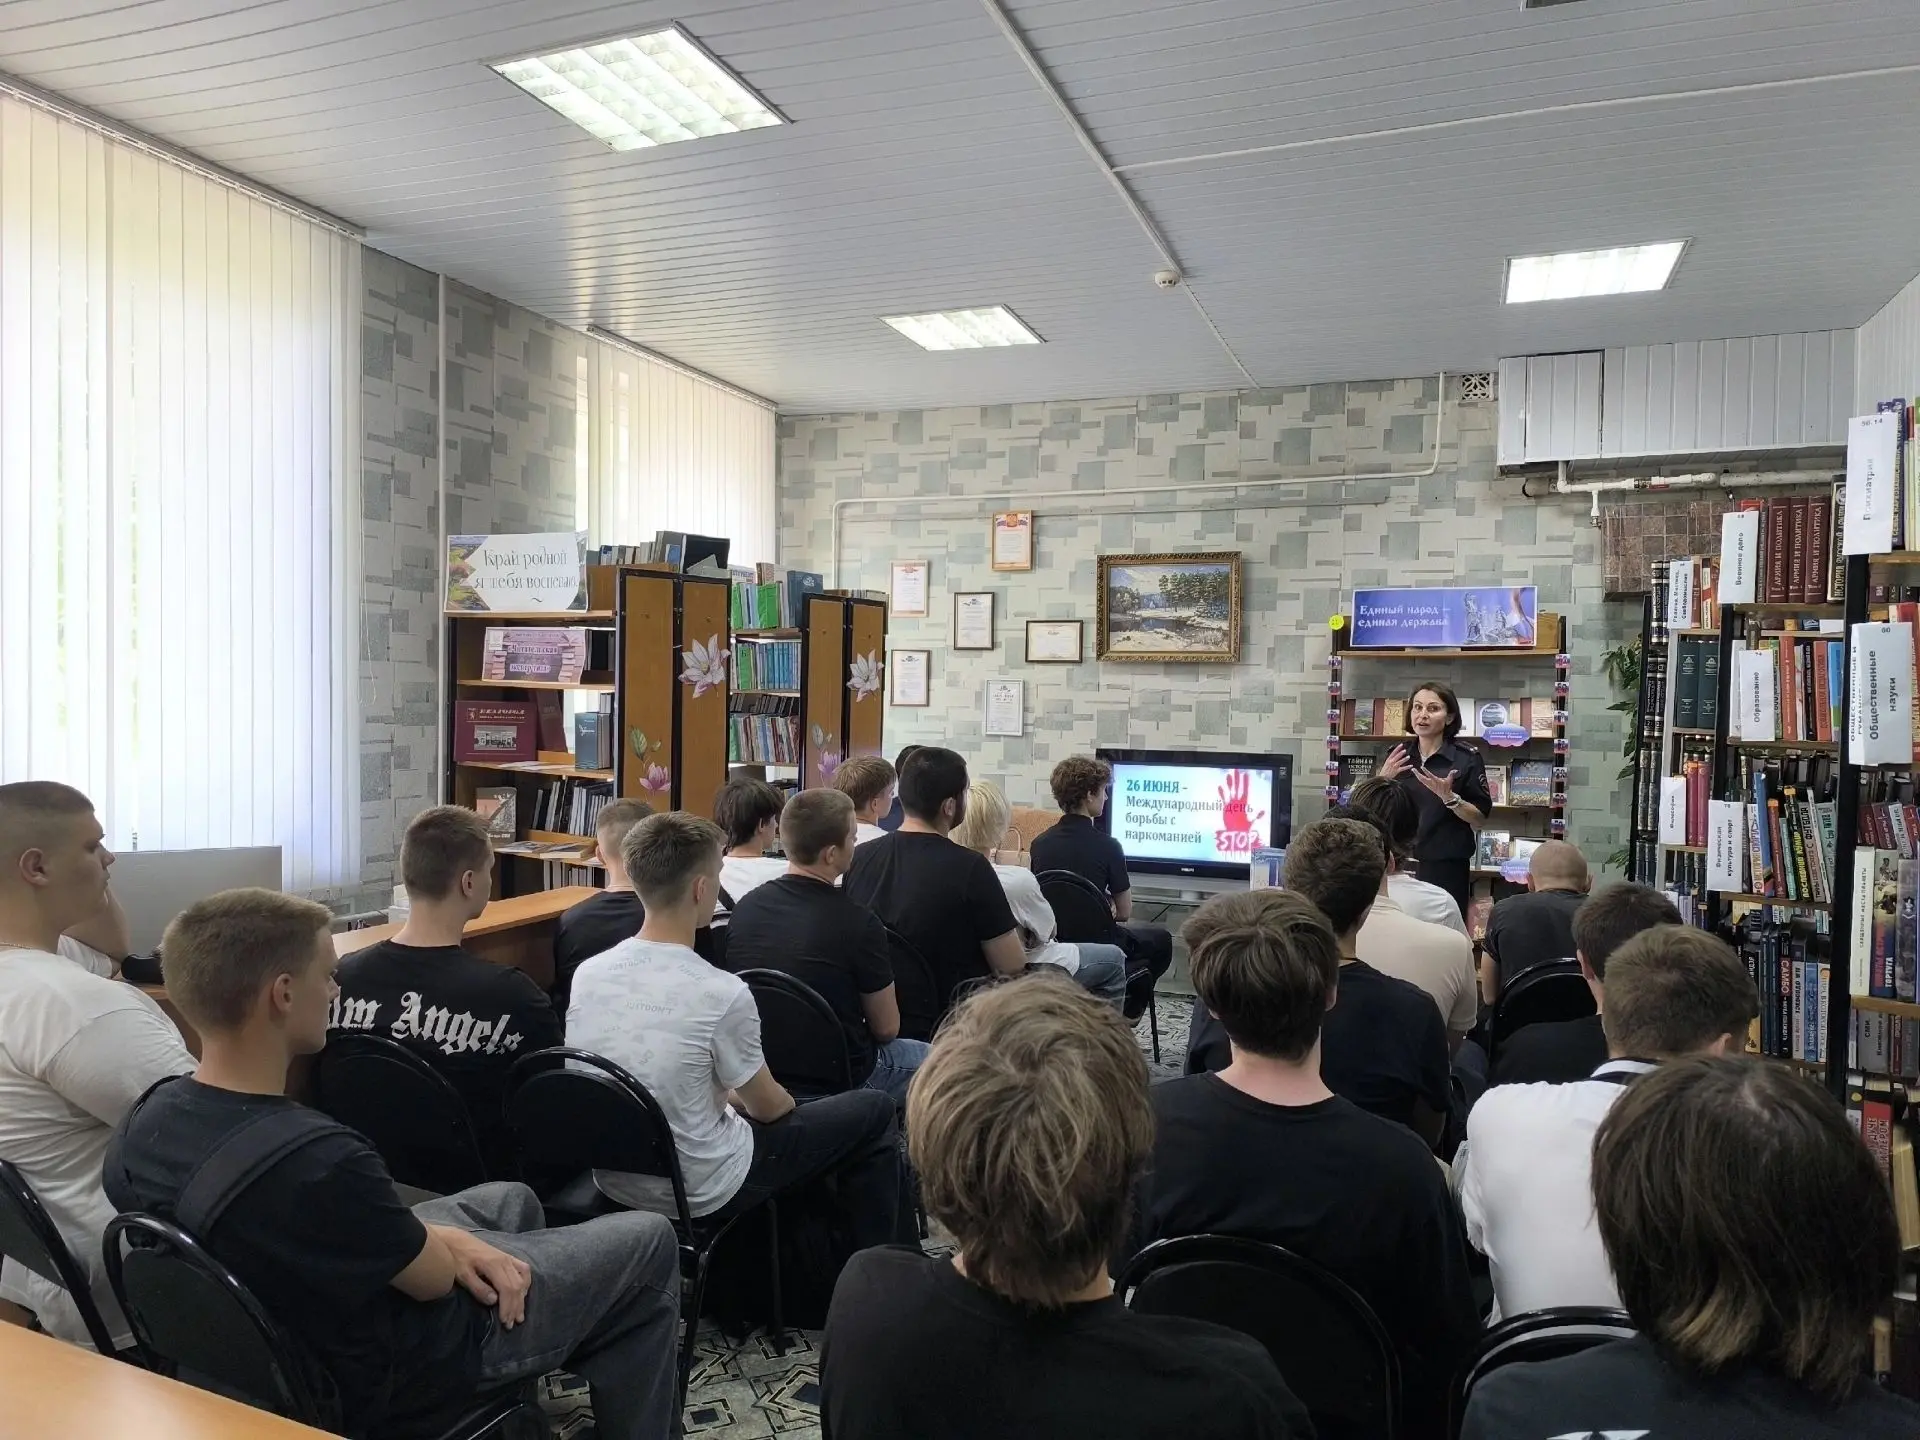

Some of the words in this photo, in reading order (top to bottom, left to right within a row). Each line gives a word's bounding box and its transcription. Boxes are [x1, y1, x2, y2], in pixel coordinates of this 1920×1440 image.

[1775, 510, 1783, 551] ПОЛИТИКА
[1794, 509, 1803, 549] ПОЛИТИКА
[1812, 507, 1822, 548] ПОЛИТИКА
[484, 549, 520, 570] Край
[523, 546, 567, 569] родной
[1735, 553, 1743, 585] Военное
[1773, 561, 1782, 585] АРМИЯ
[1793, 559, 1801, 583] АРМИЯ
[1812, 558, 1820, 582] АРМИЯ
[474, 578, 485, 589] я
[490, 572, 523, 589] тебя
[1833, 565, 1845, 596] ИСТОРИЯ
[1358, 618, 1398, 627] единая
[1401, 618, 1449, 629] держава
[1360, 605, 1403, 616] Единый
[1407, 606, 1439, 616] народ
[1753, 671, 1762, 723] Образование
[1868, 650, 1879, 740] Общественные
[1888, 677, 1898, 712] науки
[1126, 779, 1141, 792] 26
[1142, 780, 1180, 793] ИЮНЯ
[1125, 812, 1168, 826] борьбы
[1170, 816, 1176, 825] с
[1126, 795, 1222, 813] Международный
[1226, 802, 1253, 813] день
[1125, 829, 1202, 844] наркоманией
[1726, 818, 1734, 838] спорт
[1801, 807, 1813, 840] ФУТБОЛА
[1220, 831, 1259, 850] STOP
[1726, 846, 1734, 876] культура
[1796, 856, 1810, 897] ПОСЛЕДНИЙ
[1781, 960, 1789, 993] САМБО
[1884, 957, 1893, 987] ТОРТУГА
[329, 986, 382, 1029] lm
[391, 991, 524, 1056] Angels
[1867, 1117, 1877, 1140] ДУЧЕ
[1878, 1120, 1888, 1165] ИТЛЕРОМ
